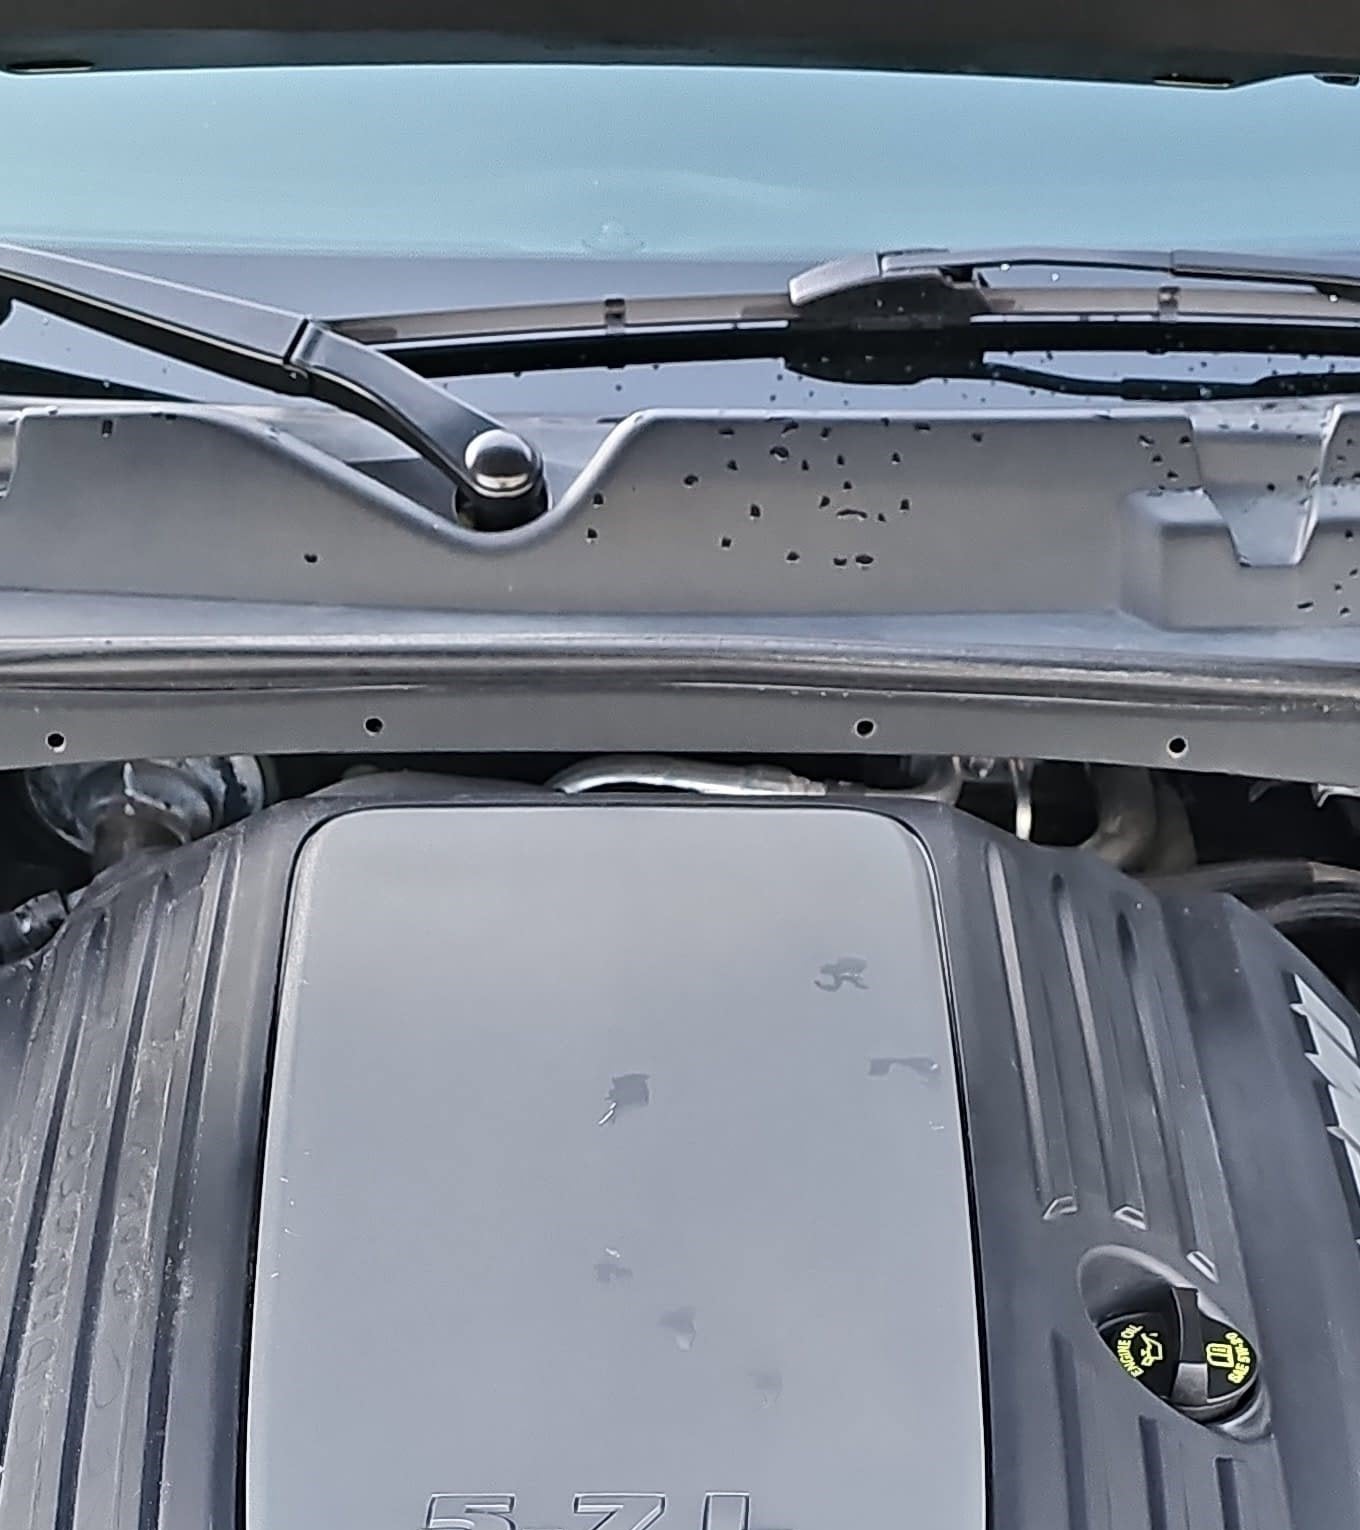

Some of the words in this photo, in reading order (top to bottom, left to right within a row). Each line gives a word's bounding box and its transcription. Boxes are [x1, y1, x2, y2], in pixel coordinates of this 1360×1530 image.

[1120, 1324, 1144, 1339] OIL
[1117, 1339, 1144, 1378] ENGINE
[1227, 1363, 1250, 1384] SAE
